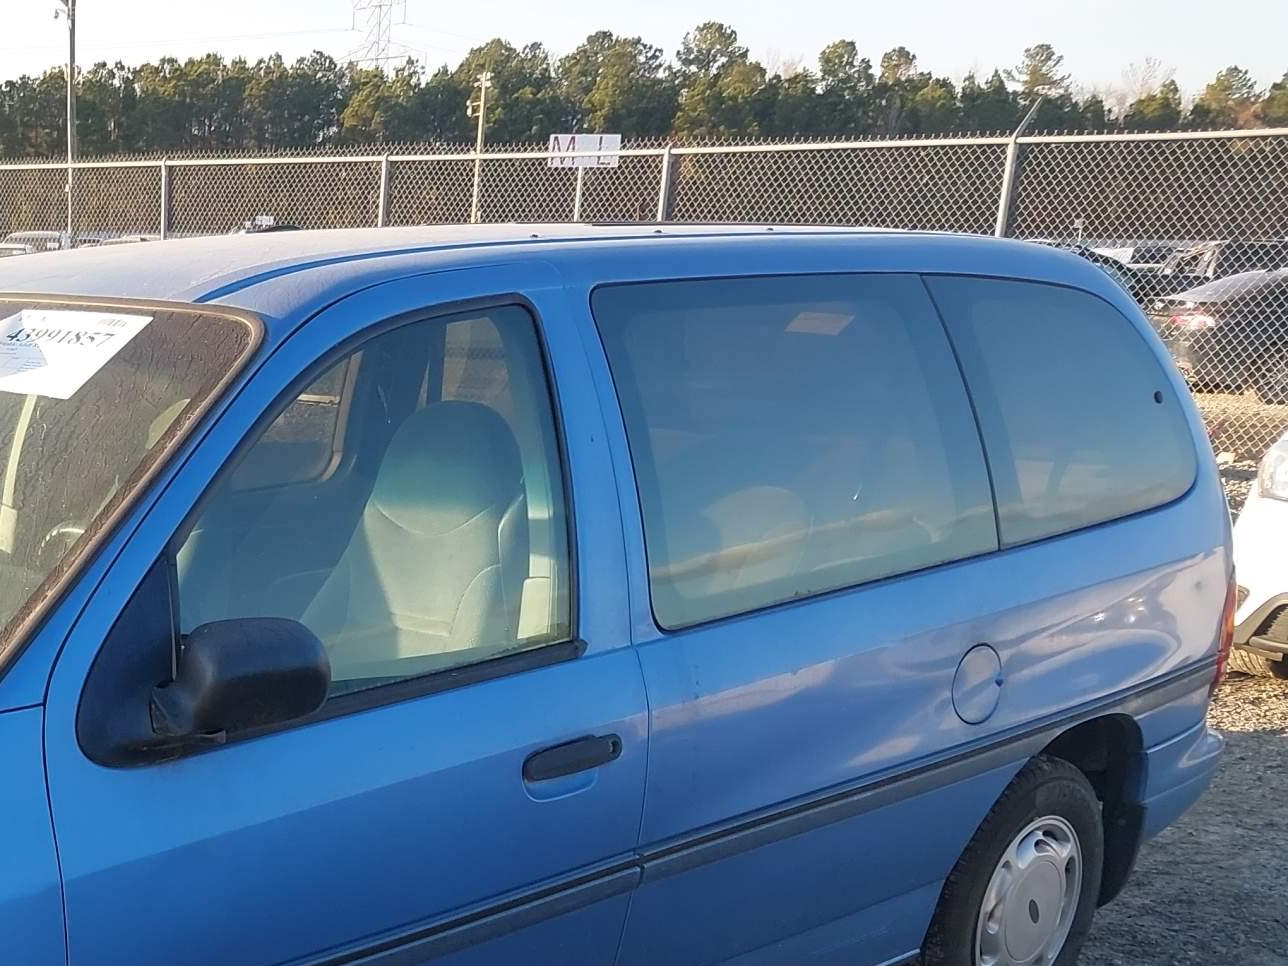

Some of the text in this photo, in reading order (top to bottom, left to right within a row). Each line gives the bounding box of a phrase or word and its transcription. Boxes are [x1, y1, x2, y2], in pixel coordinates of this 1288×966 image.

[551, 135, 611, 166] M L
[6, 327, 116, 348] 43991857
